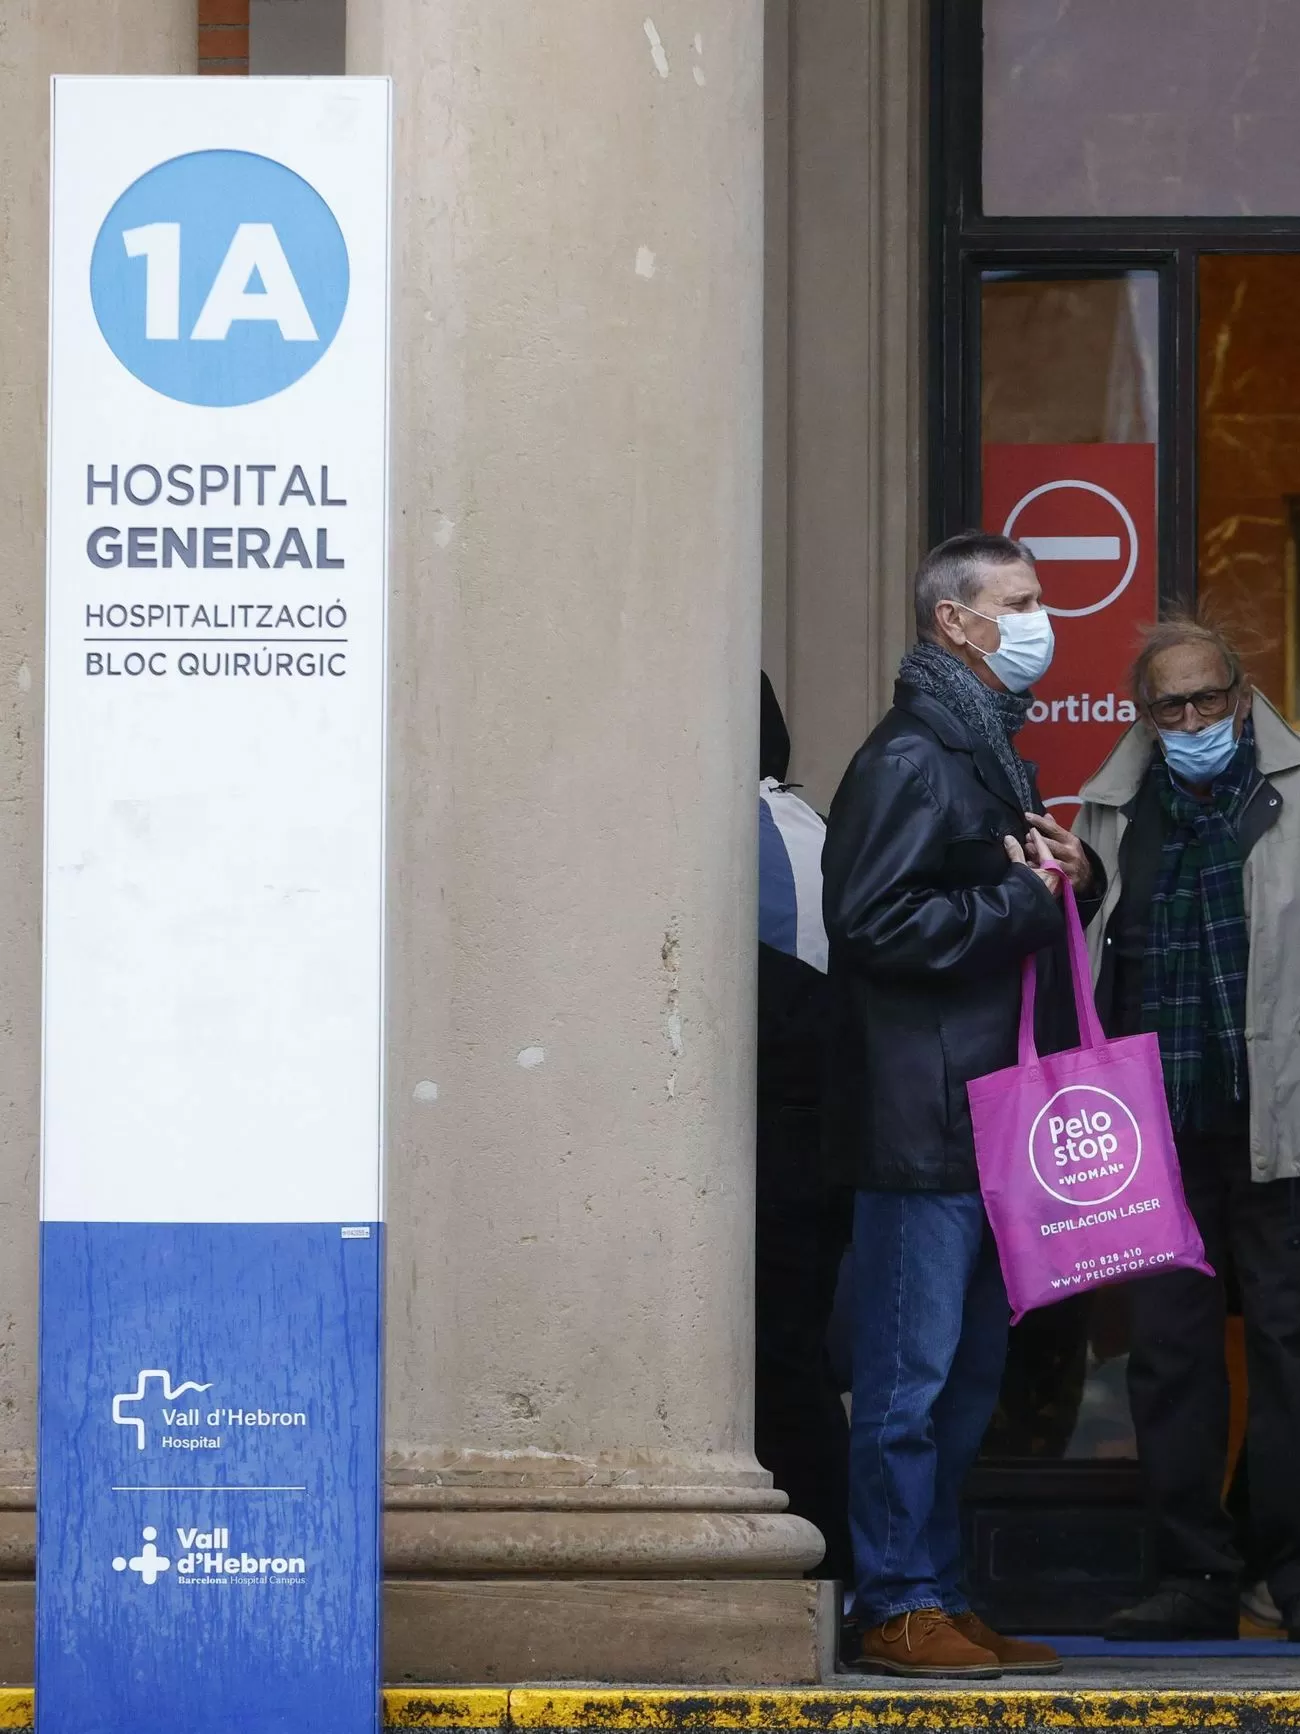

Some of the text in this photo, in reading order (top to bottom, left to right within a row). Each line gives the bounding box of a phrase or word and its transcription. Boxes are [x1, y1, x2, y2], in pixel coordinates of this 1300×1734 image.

[122, 222, 320, 341] 1A
[86, 464, 348, 506] HOSPITAL
[86, 526, 346, 569] GENERAL
[85, 598, 348, 629] HOSPITALITZACIÓ
[86, 646, 347, 677] BLOC QUIRÚRGIC
[1026, 693, 1136, 723] ortida
[1049, 1109, 1111, 1144] Pelo
[1054, 1133, 1118, 1166] stop
[1064, 1163, 1119, 1185] WOMAN
[1051, 1251, 1175, 1288] WWW.PELOSTOP.COM
[1075, 1247, 1142, 1271] 900 828 410
[162, 1409, 306, 1426] Vall d'Hebron
[162, 1436, 221, 1451] Hospital
[176, 1528, 228, 1549] Vall
[177, 1552, 306, 1574] d'Hebron
[178, 1576, 306, 1587] Barcelona Hospital Campus
